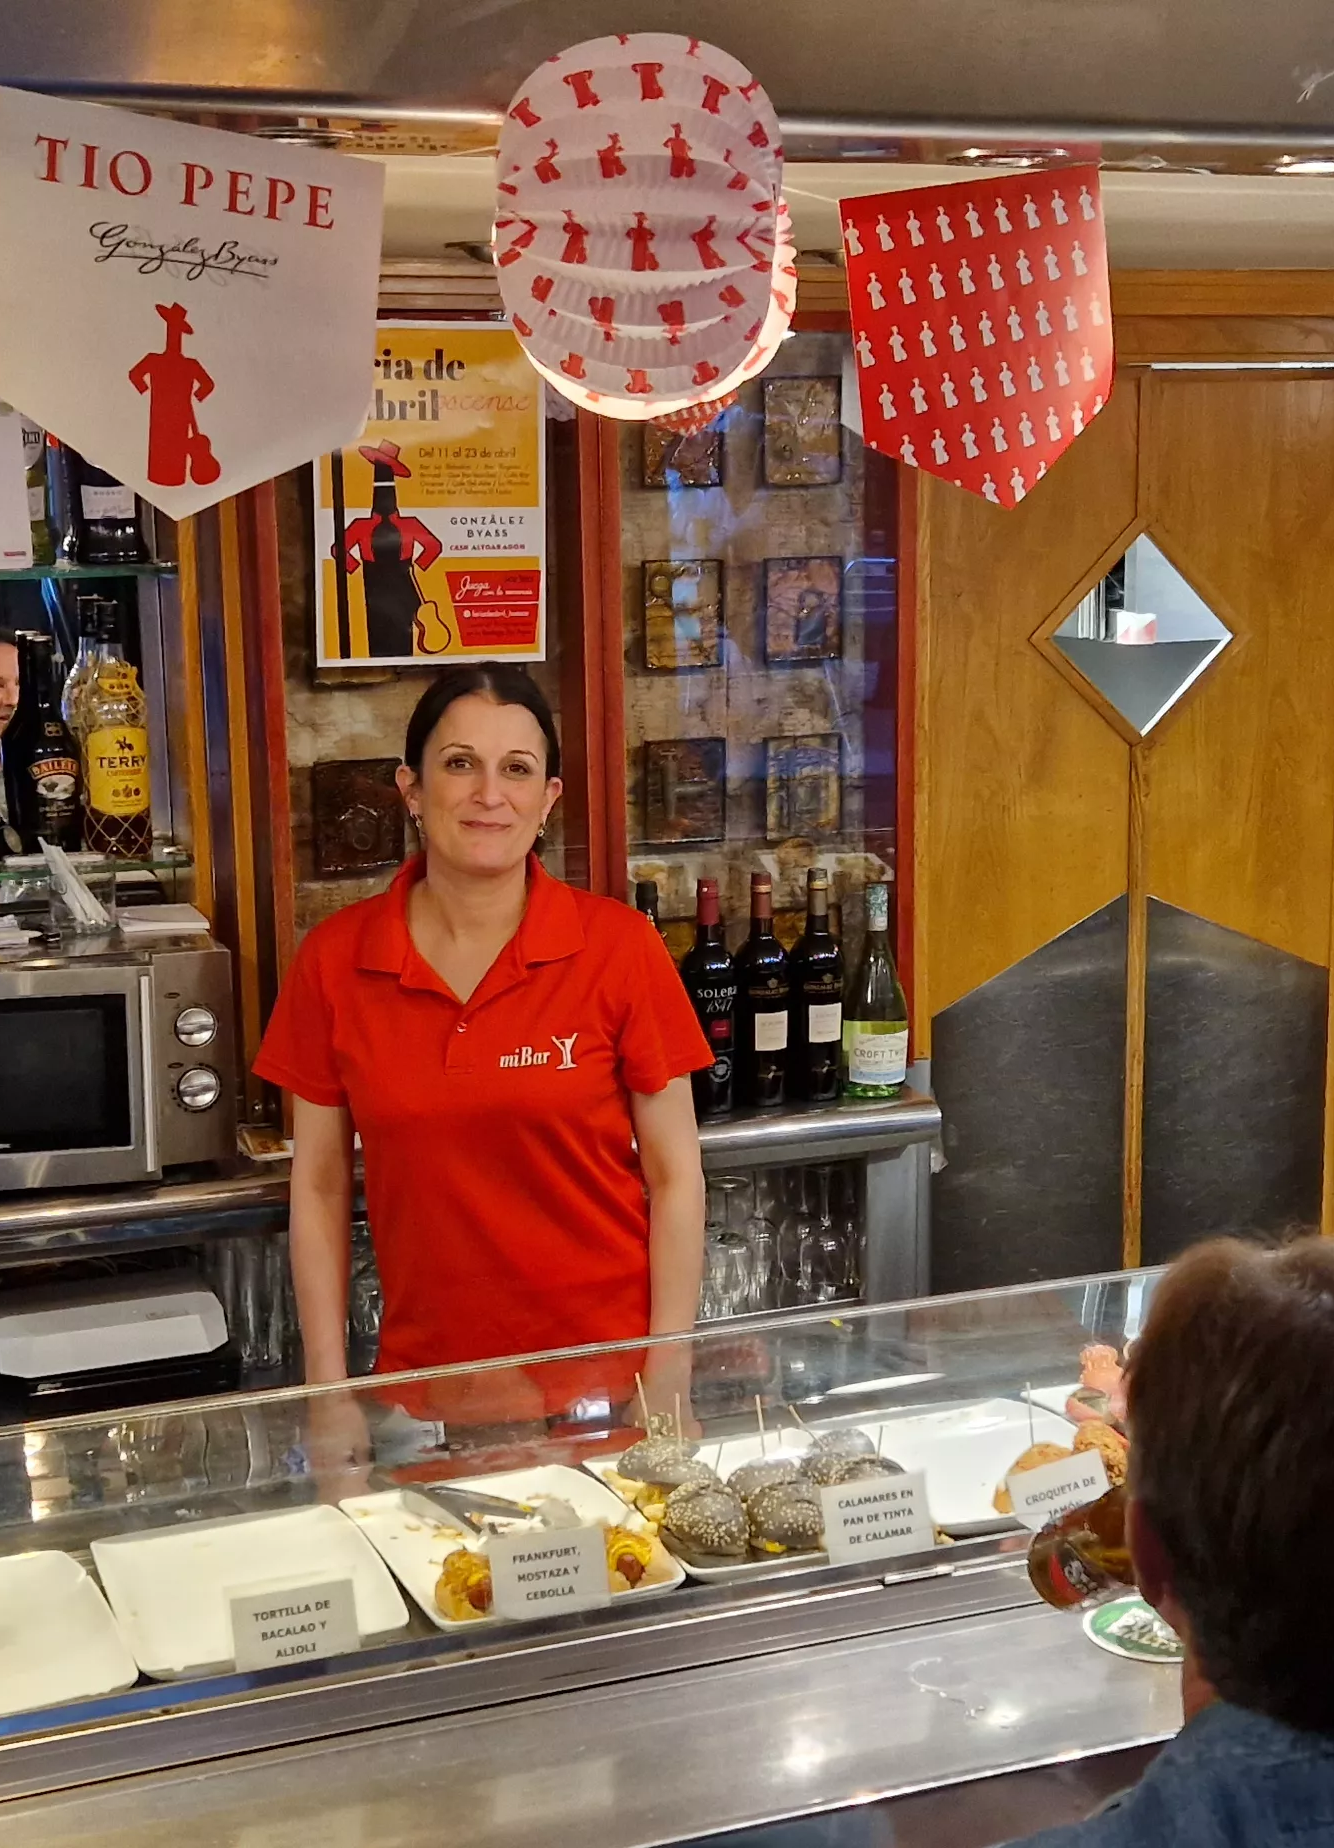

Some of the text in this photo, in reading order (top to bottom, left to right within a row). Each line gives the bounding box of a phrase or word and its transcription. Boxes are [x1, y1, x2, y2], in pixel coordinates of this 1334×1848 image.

[34, 133, 335, 229] TIO PEPE
[424, 348, 465, 381] de
[368, 389, 440, 421] bril
[419, 447, 516, 458] Del 11 al 23 de abril
[467, 529, 508, 538] BYASS
[96, 754, 147, 769] TERRY
[499, 1046, 551, 1068] miBar
[854, 1048, 886, 1058] CROFT
[838, 1489, 914, 1509] CALAMARES EN
[1025, 1475, 1097, 1507] CROQUETA DE
[843, 1507, 914, 1527] PAN DE TINTA
[849, 1526, 913, 1544] DE CALAMAR
[512, 1546, 581, 1565] FRANKFURT,
[517, 1565, 580, 1582] MOSTAZA Y
[526, 1585, 576, 1601] CEBOLLA
[253, 1600, 331, 1622] TORTILLA DE
[261, 1620, 327, 1641] BACALAO Y
[275, 1642, 317, 1659] ALIOLI
